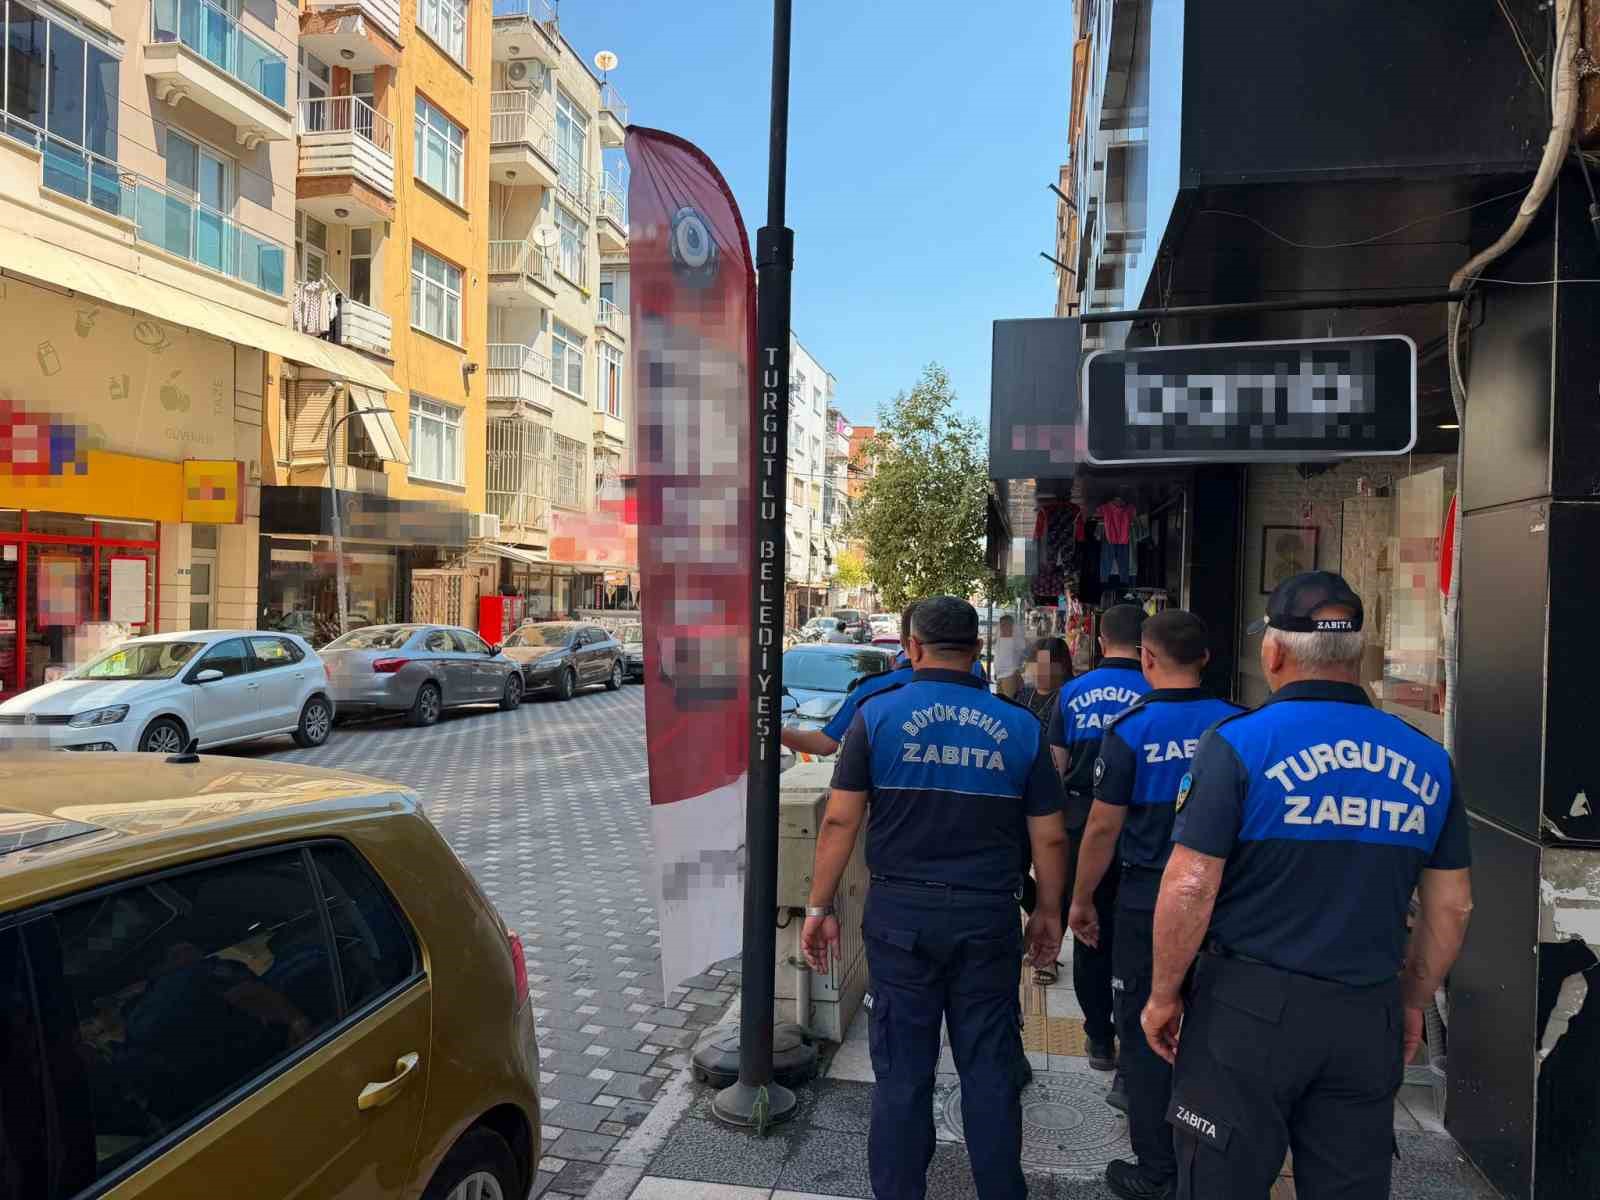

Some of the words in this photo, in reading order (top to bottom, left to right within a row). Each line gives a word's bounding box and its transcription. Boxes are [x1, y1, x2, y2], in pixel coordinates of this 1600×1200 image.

[761, 347, 780, 520] TURGUTLU
[1317, 621, 1352, 629] ZABITA
[756, 541, 775, 761] BELEDİYESİ
[1068, 686, 1141, 713] TURGUT
[902, 703, 1008, 744] BÜYÜKŞEHİR
[1075, 713, 1119, 729] ZAB
[903, 743, 1005, 770] ZABITA
[1144, 739, 1200, 763] ZAB
[1264, 740, 1440, 805] TURGUTLU
[1284, 795, 1425, 834] ZABITA
[1176, 1106, 1216, 1138] ZABITA
